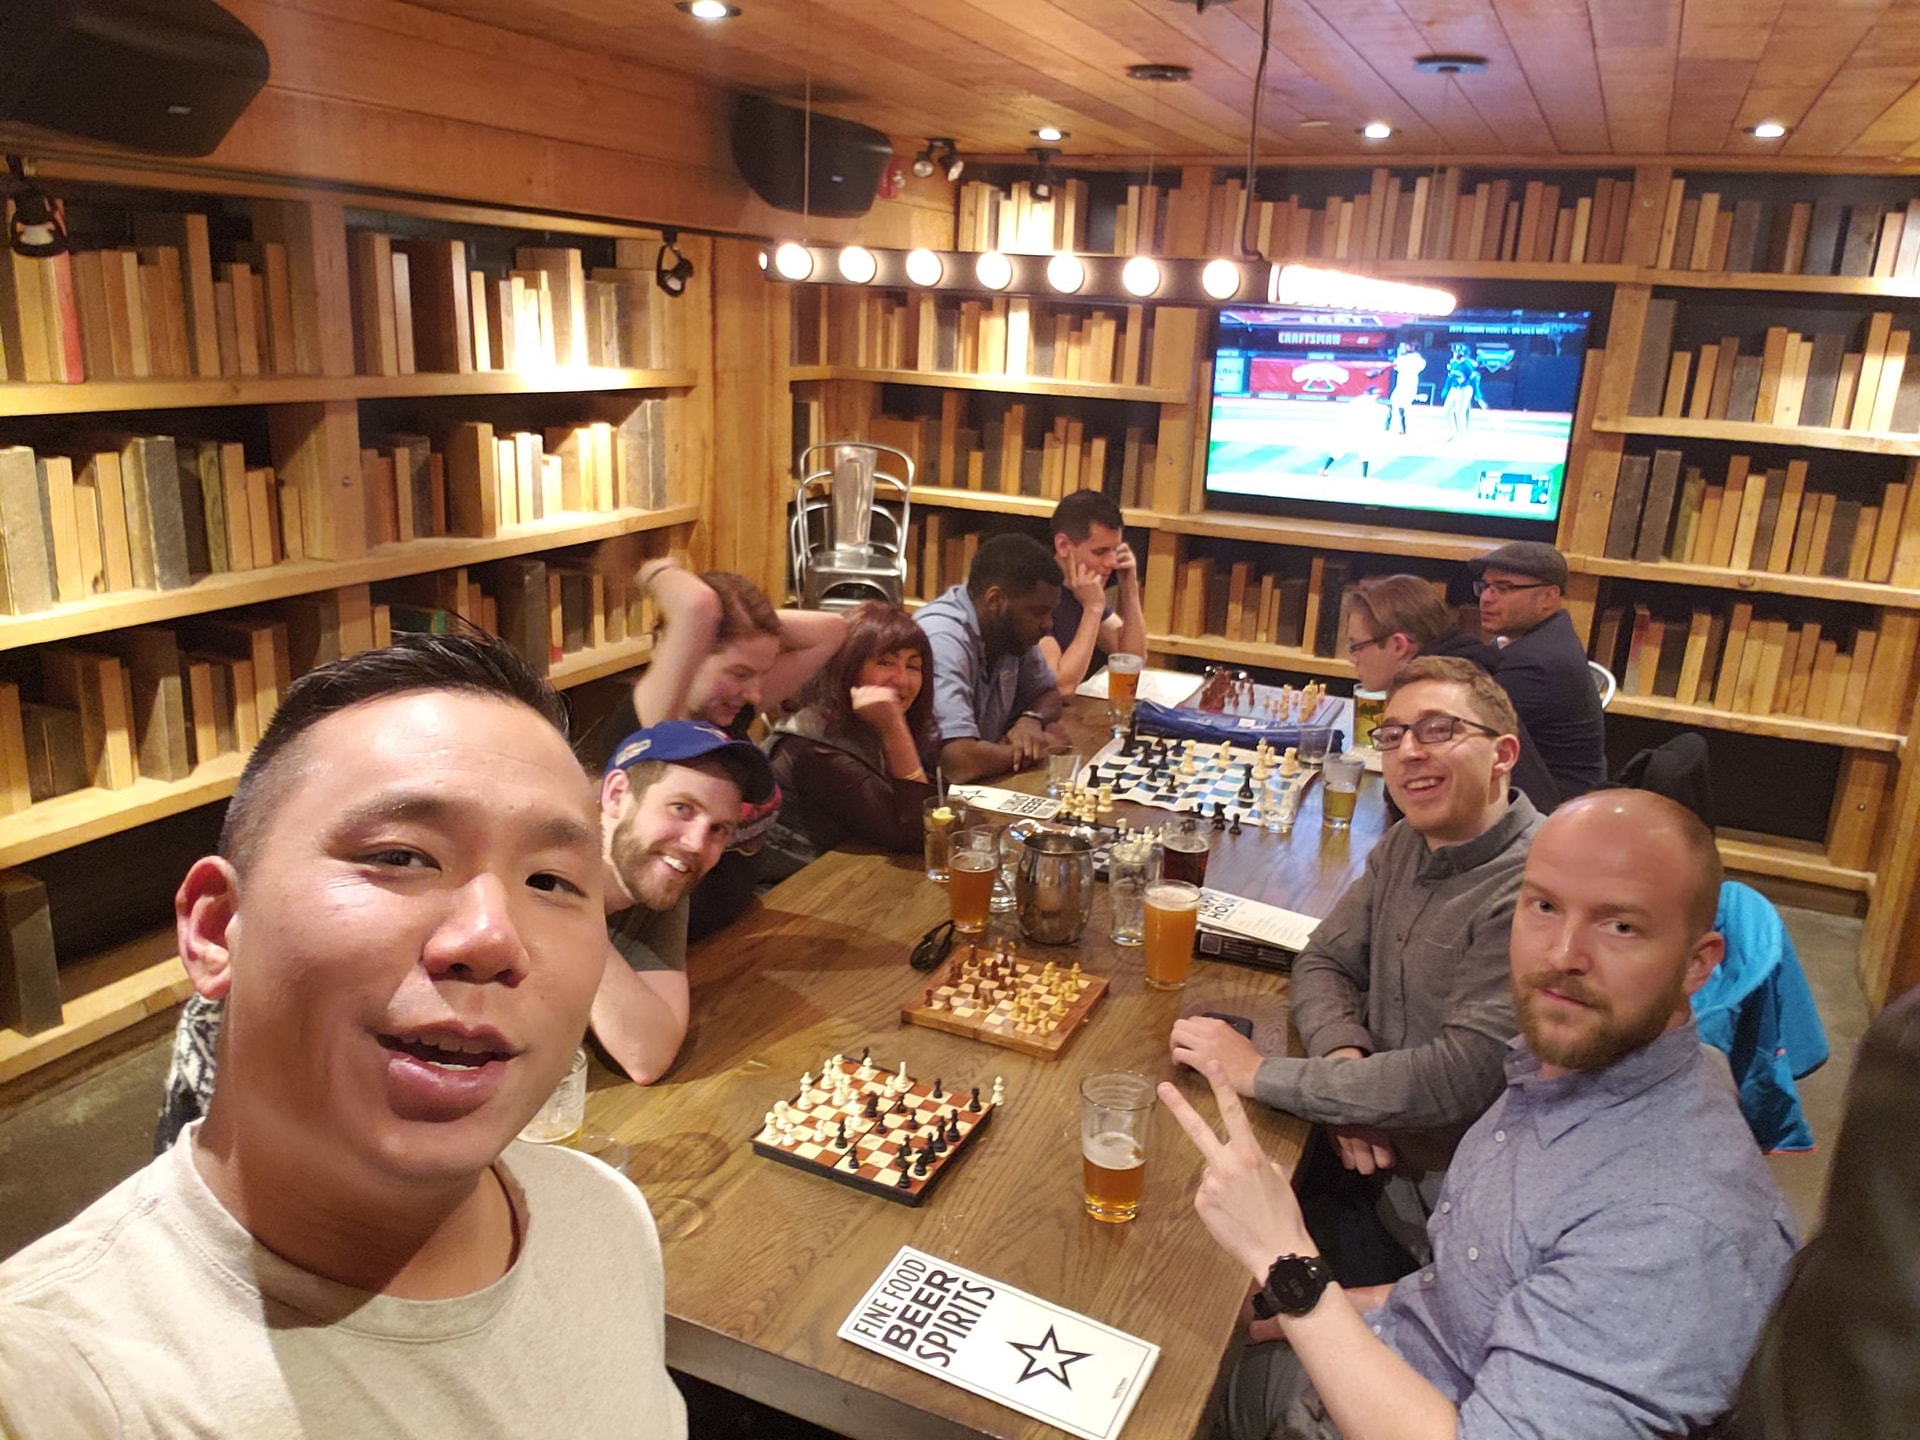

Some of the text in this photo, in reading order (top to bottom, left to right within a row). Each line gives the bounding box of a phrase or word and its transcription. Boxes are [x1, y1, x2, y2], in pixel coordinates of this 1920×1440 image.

[1278, 331, 1341, 345] CRAFTSMAN
[853, 1259, 927, 1338] FINE FOOD
[881, 1269, 960, 1352] BEER
[915, 1280, 995, 1368] SPIRITS
